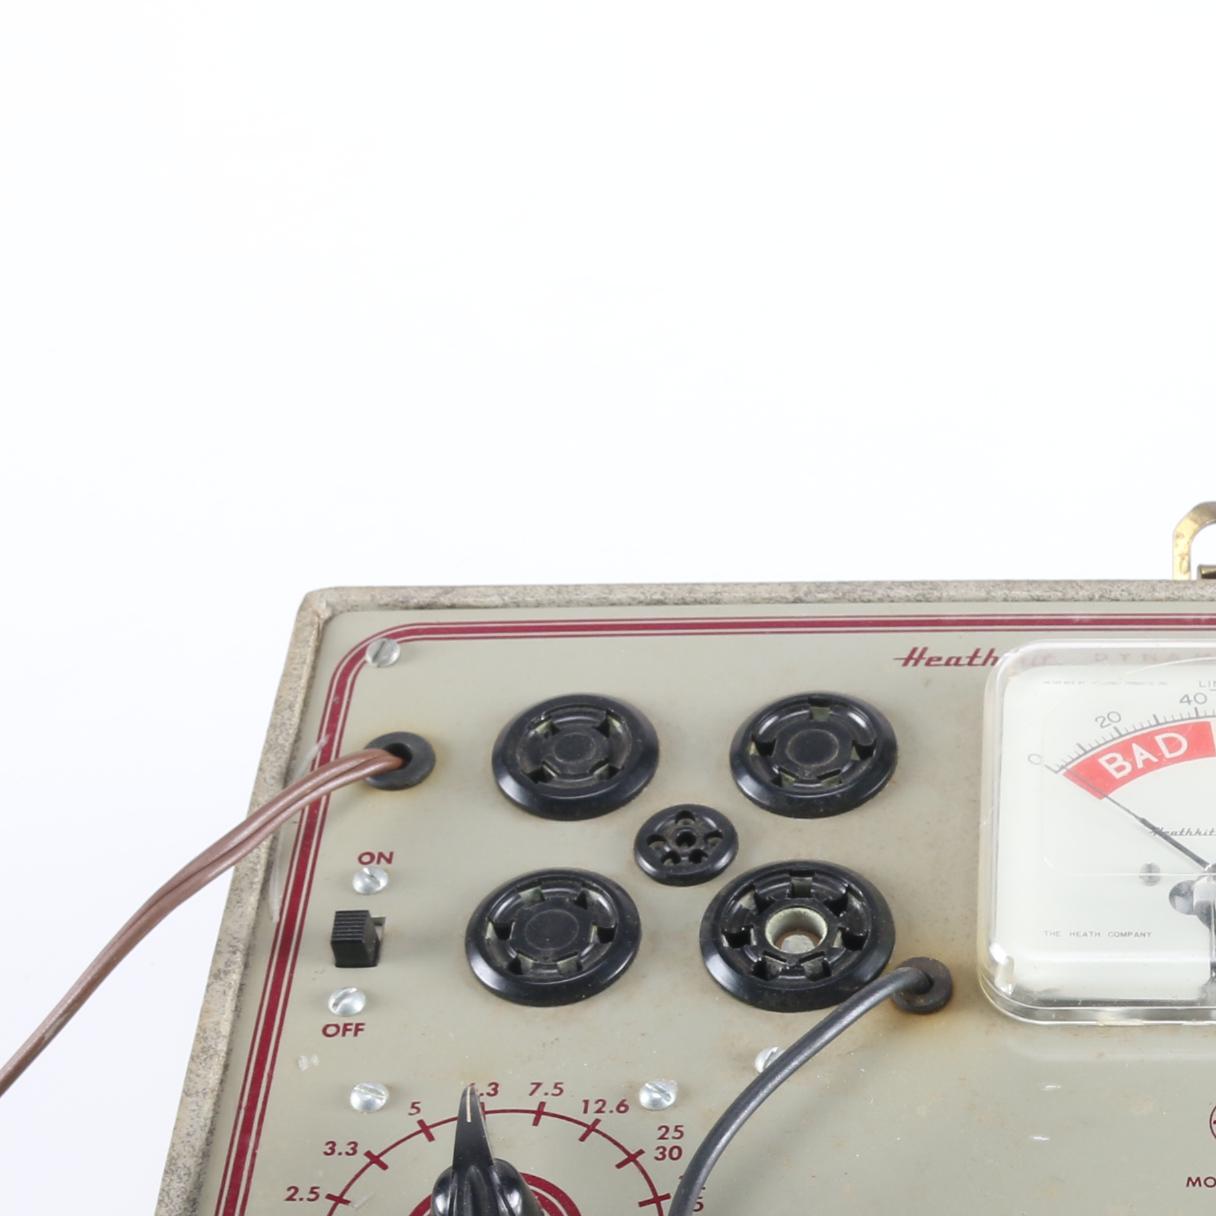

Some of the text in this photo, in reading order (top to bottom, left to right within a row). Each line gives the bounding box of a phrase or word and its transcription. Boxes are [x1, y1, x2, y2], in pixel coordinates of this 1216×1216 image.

[1178, 692, 1208, 706] 40
[1094, 711, 1123, 729] 20
[1027, 753, 1044, 766] 0
[1099, 733, 1188, 779] BAD
[358, 852, 393, 865] ON
[322, 1023, 365, 1037] OFF
[529, 1082, 563, 1096] 7.5
[409, 1102, 420, 1115] 5
[583, 1099, 629, 1114] 12.6
[658, 1125, 684, 1140] 25
[323, 1141, 358, 1156] 3.3
[654, 1145, 682, 1161] 30
[285, 1186, 320, 1201] 2.5
